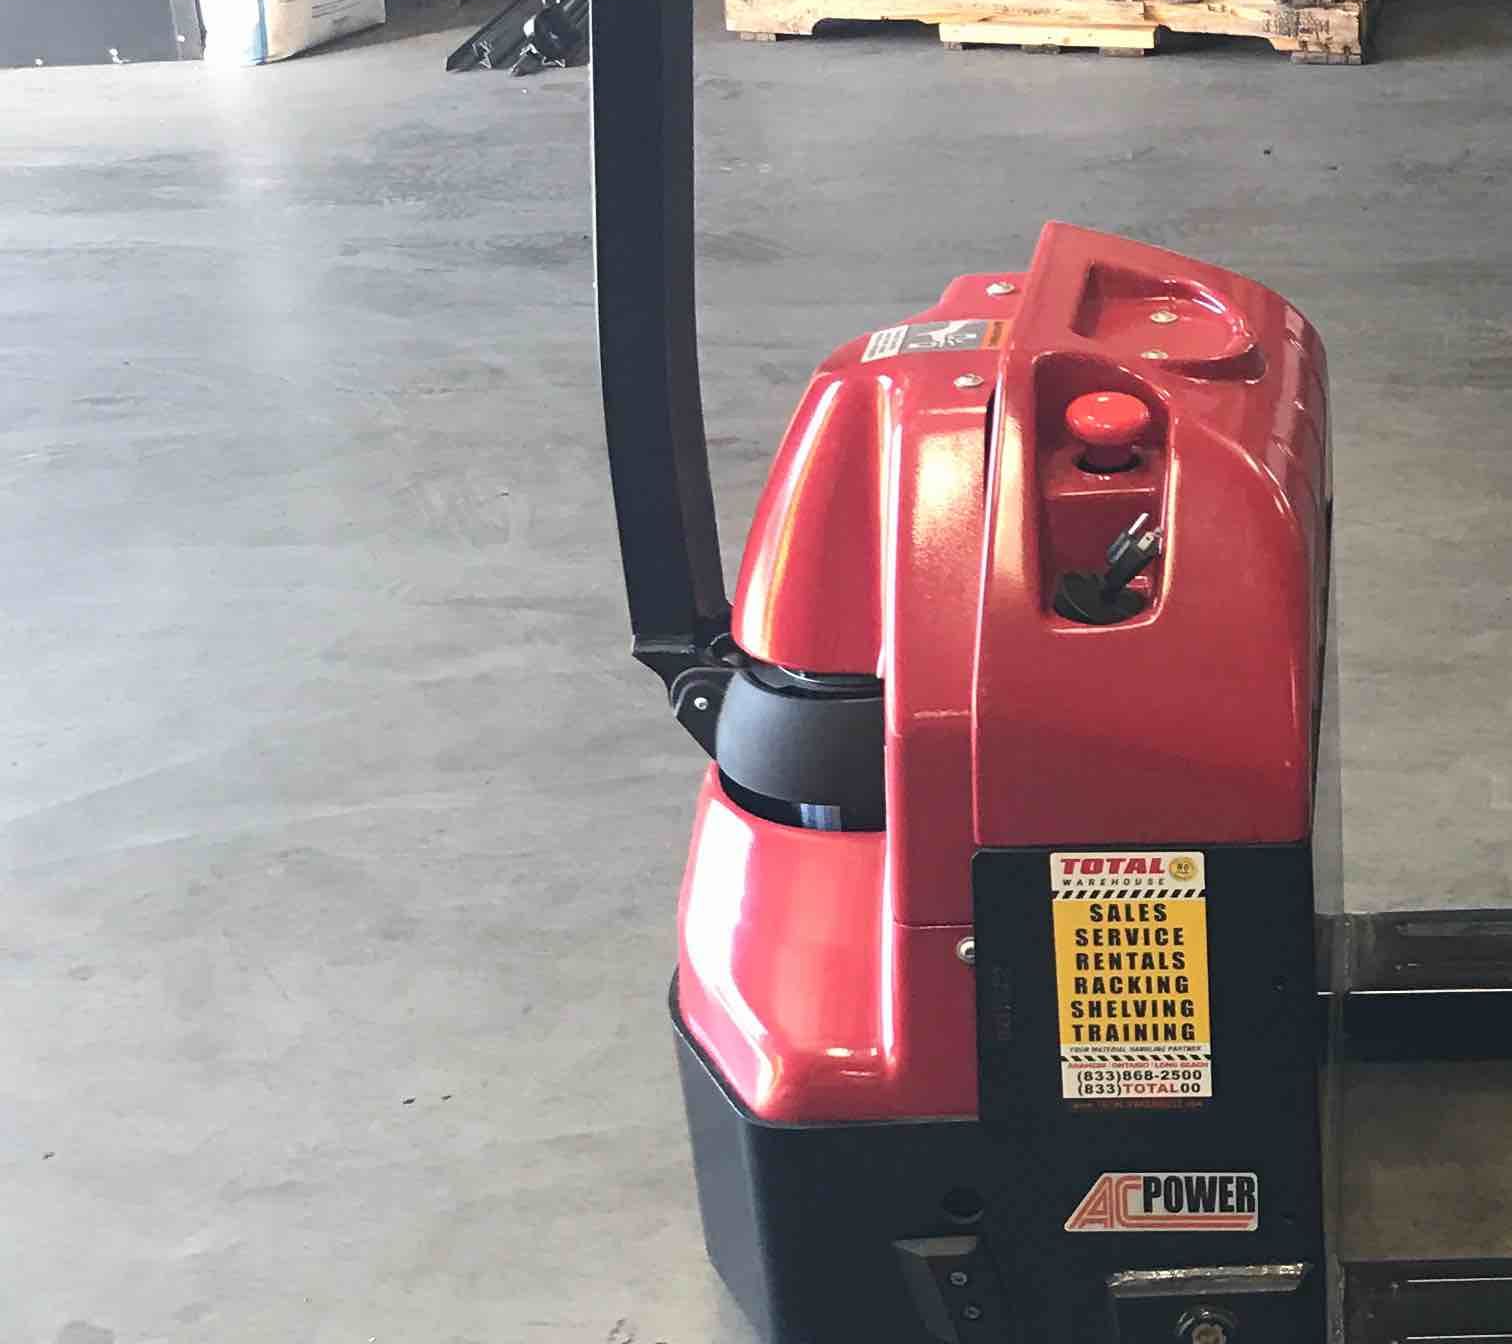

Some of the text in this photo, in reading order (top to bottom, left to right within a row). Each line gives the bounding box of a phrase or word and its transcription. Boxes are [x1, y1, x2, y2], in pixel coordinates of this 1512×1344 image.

[1061, 858, 1166, 875] TOTAL
[1062, 878, 1166, 887] WAREHOUSE
[1090, 903, 1168, 922] SALES
[1075, 927, 1185, 947] SERVICE
[1076, 951, 1185, 971] RENTALS
[1074, 975, 1189, 994] RACKING
[1070, 999, 1195, 1018] SHELVING
[1072, 1023, 1195, 1042] TRAINING
[1077, 1070, 1202, 1082] (833)868-2500
[1078, 1083, 1201, 1096] (833)TOTAL00
[1143, 1176, 1256, 1213] POWER
